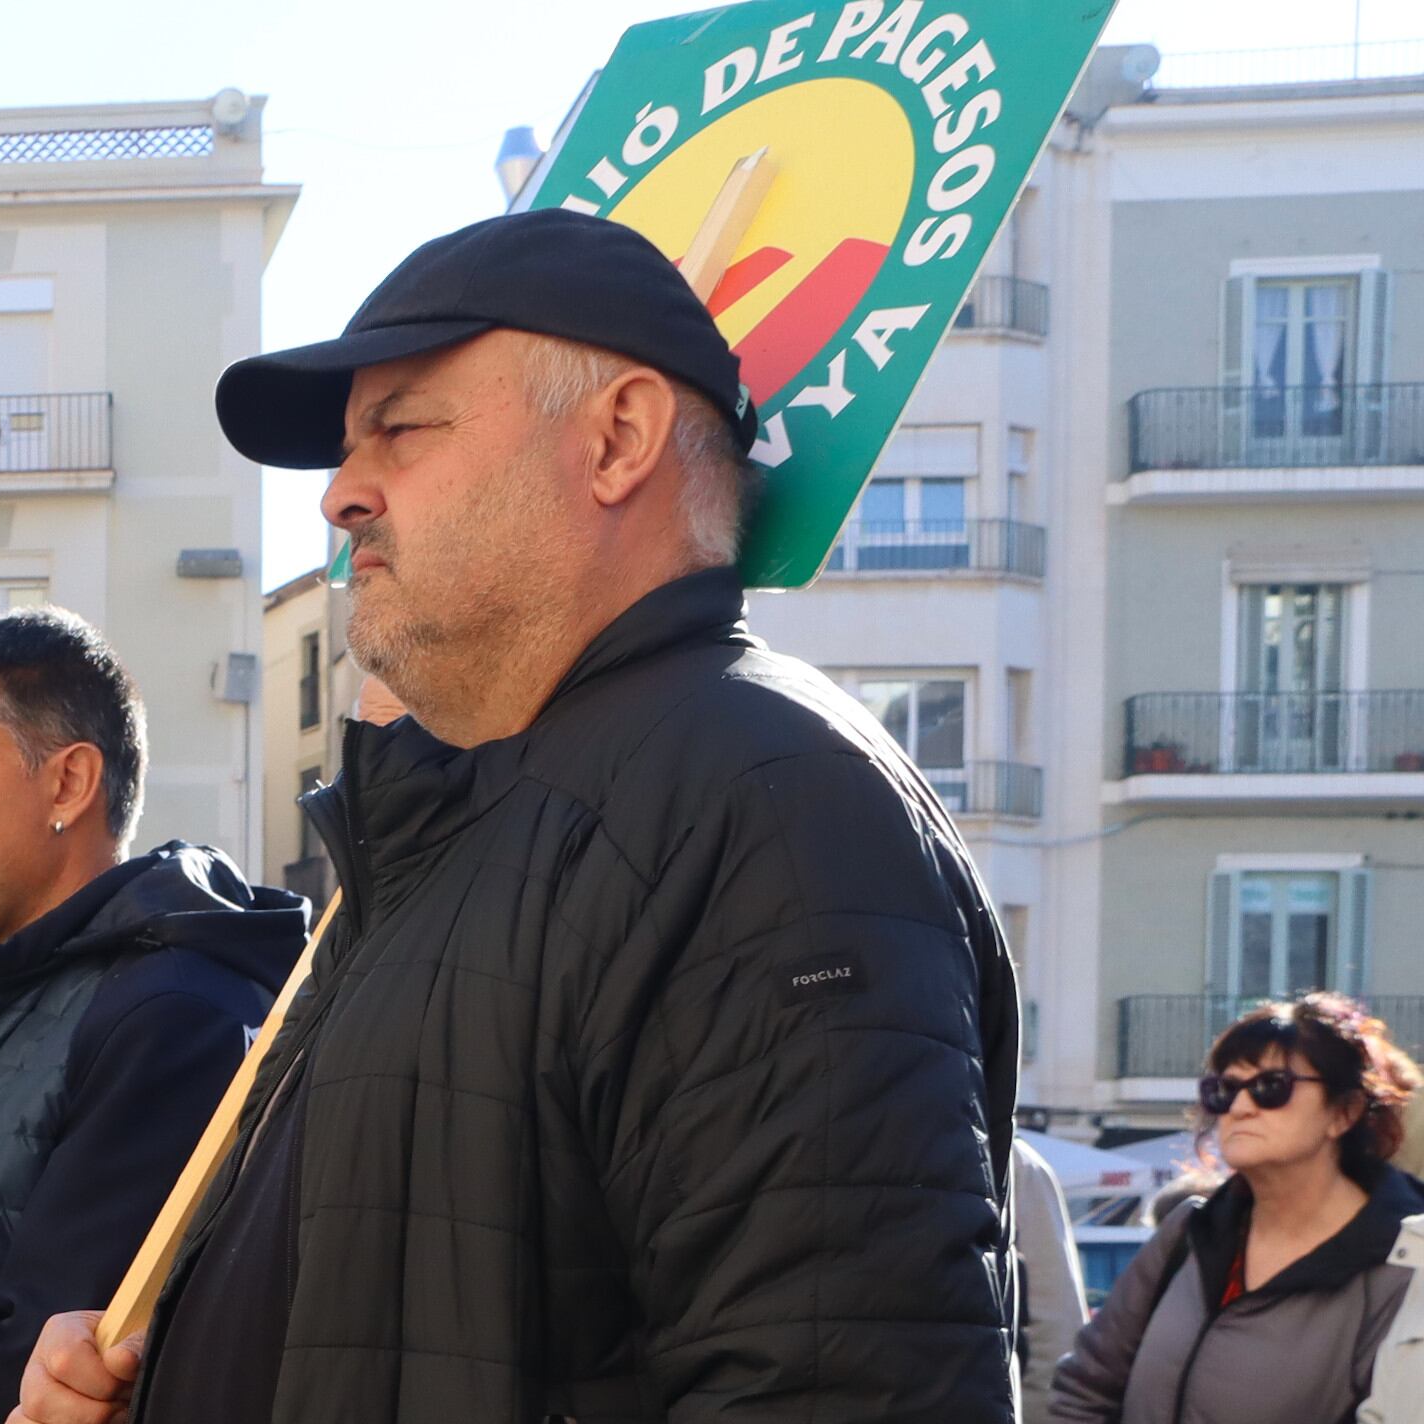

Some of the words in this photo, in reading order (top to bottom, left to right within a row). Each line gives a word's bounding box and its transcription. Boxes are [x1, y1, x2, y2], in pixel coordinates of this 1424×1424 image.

[701, 12, 814, 116] DE
[817, 0, 1002, 268] PAGESOS
[792, 966, 852, 987] FORCLAZ
